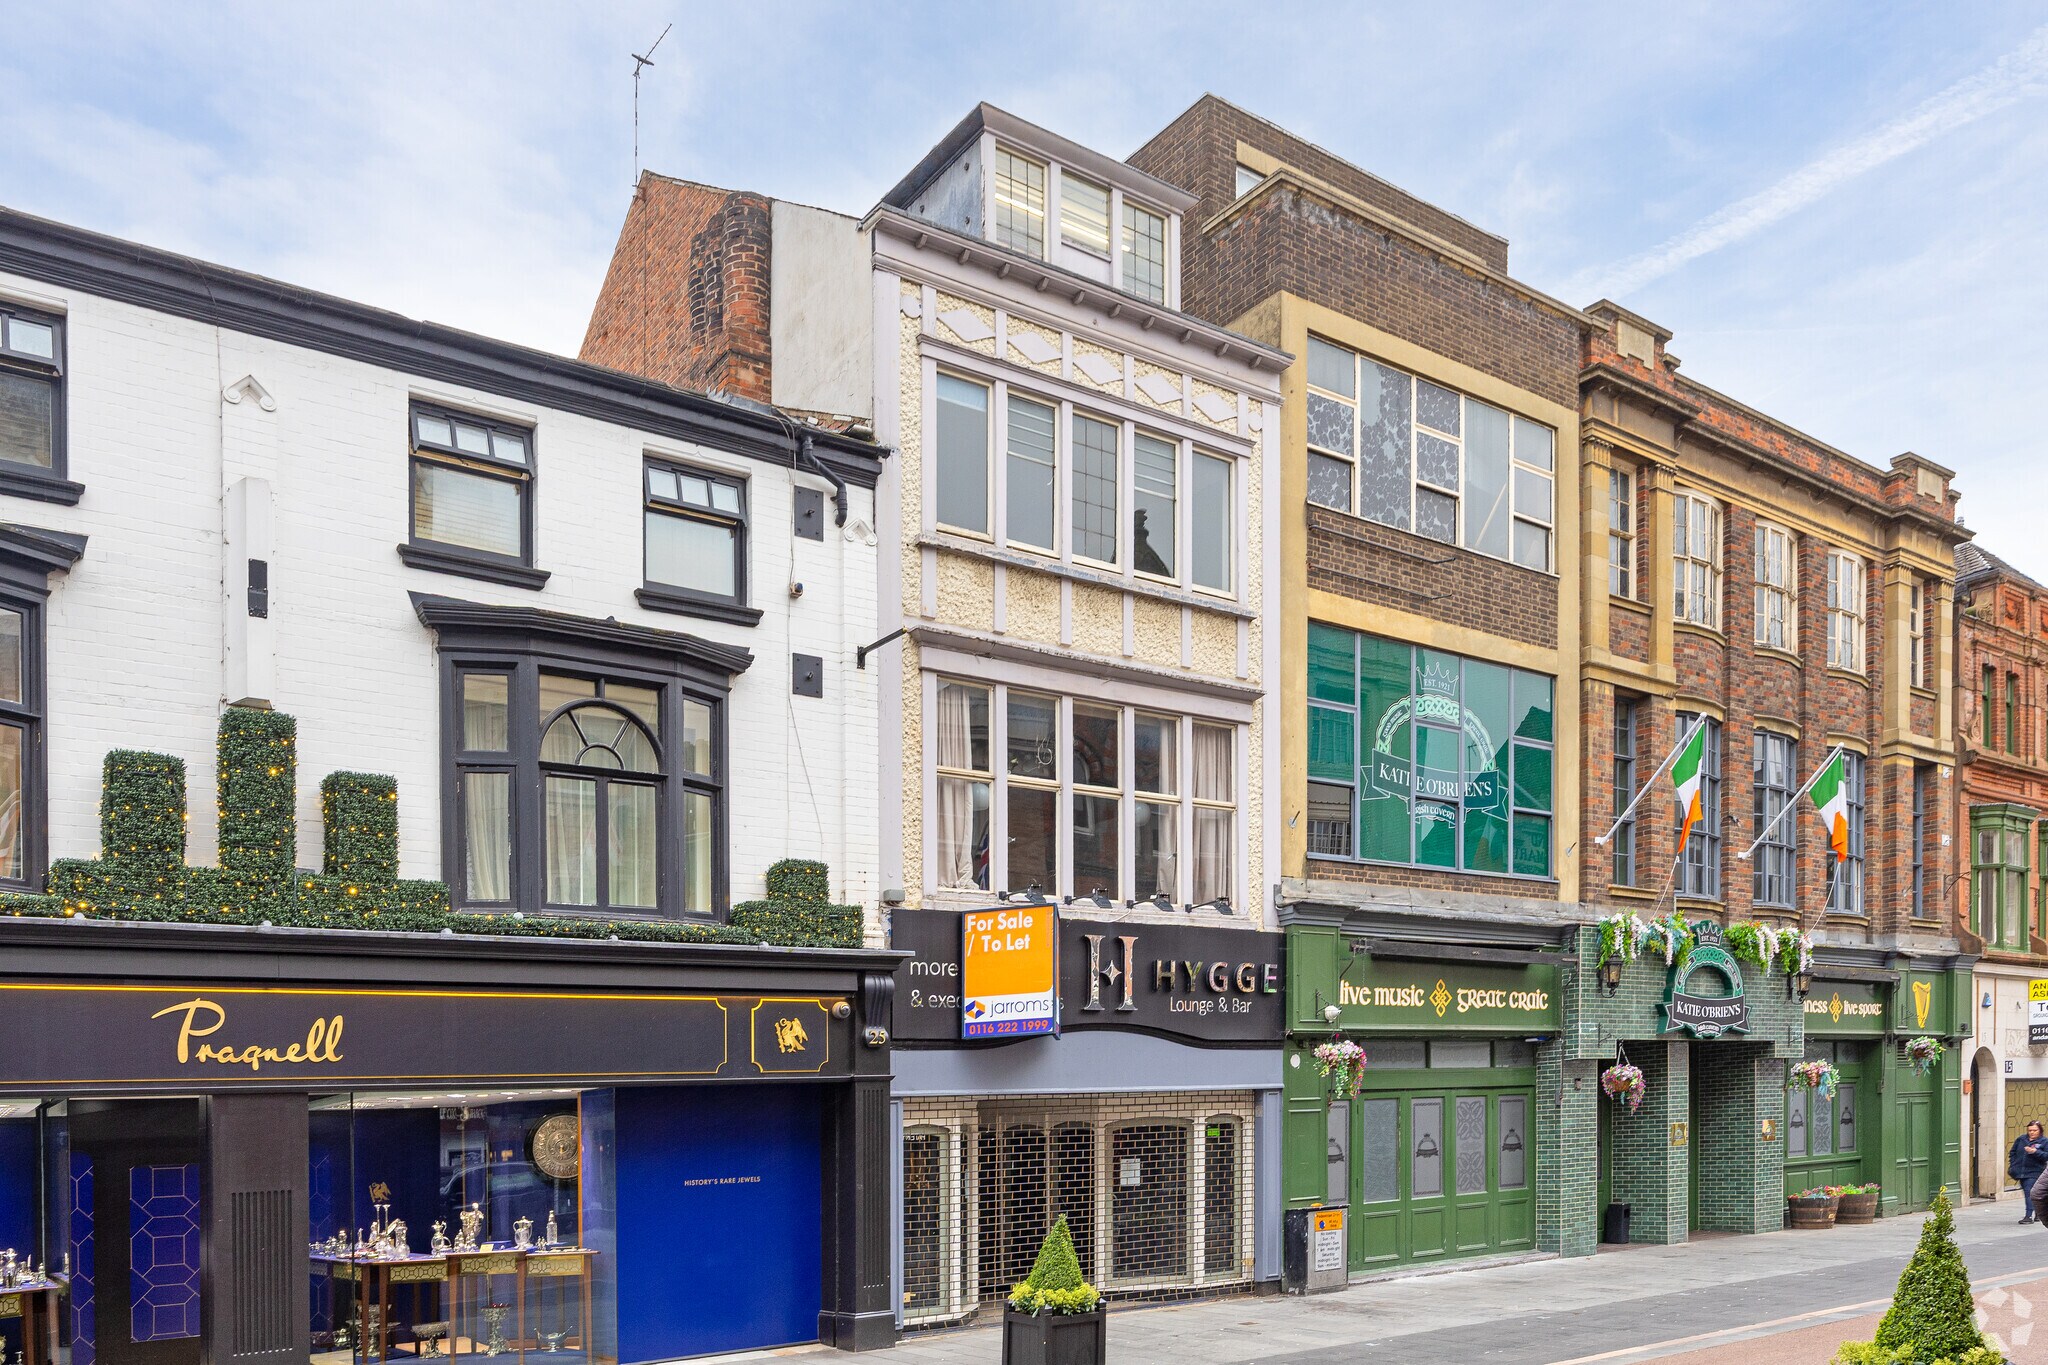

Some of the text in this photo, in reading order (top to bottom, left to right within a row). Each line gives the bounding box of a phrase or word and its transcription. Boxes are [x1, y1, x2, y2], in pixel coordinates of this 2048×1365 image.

[1424, 678, 1450, 691] EST. 1921
[1379, 763, 1492, 798] KATIE O'BRIEN'S
[967, 915, 994, 932] For
[997, 911, 1033, 930] Sale
[981, 935, 1002, 952] To
[1006, 934, 1030, 950] Let
[910, 961, 958, 977] more
[1154, 958, 1278, 993] HYGGE
[911, 989, 924, 1008] &
[1340, 980, 1424, 1007] live music
[1457, 988, 1548, 1013] great craic
[990, 1000, 1049, 1017] jarroms
[1170, 996, 1252, 1016] Lounge & Bar
[1676, 1001, 1740, 1018] KATIE O'BRIEN'S
[1844, 1000, 1882, 1018] live sport
[151, 997, 344, 1071] Pragnell
[969, 1020, 1048, 1035] 0116 222 1999
[868, 1030, 886, 1044] 25
[2006, 1061, 2012, 1072] 15
[684, 1178, 718, 1186] HISTORY'S
